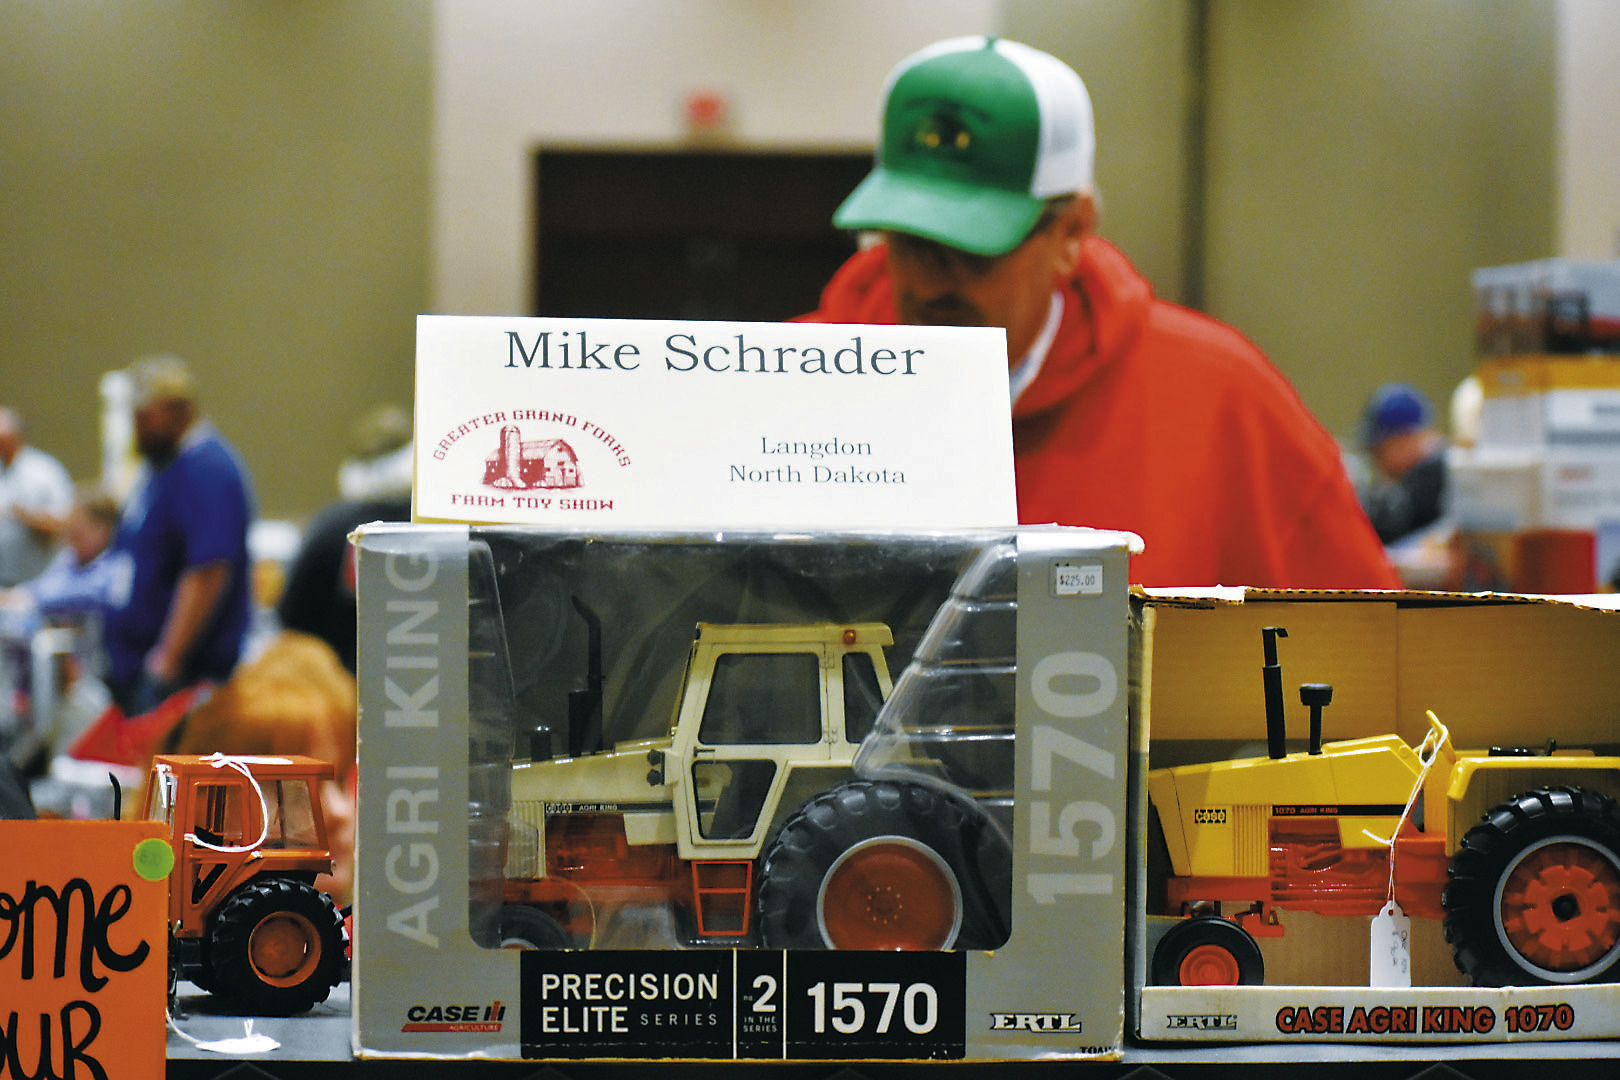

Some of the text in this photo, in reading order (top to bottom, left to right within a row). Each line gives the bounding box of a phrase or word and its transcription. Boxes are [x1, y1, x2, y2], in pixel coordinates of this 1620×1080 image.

[504, 331, 925, 376] Mike Schrader
[433, 410, 631, 467] GREATER GRAND FORKS
[761, 436, 873, 460] Langdon
[730, 464, 907, 484] North Dakota
[451, 494, 615, 511] FARM TOY SHOW
[1059, 575, 1095, 586] $225.00
[385, 551, 440, 949] AGRI KING
[1027, 652, 1118, 904] 1570
[542, 973, 718, 1000] PRECISION
[752, 974, 777, 1013] 2
[407, 1006, 480, 1021] CASE
[542, 1006, 718, 1033] ELITE SERIES
[744, 1016, 776, 1024] IN THE
[807, 981, 939, 1034] 1570
[1276, 1003, 1575, 1033] CASE AGRI KING 1070
[743, 1024, 777, 1033] SERIES
[989, 1012, 1082, 1033] ERTL
[1167, 1014, 1237, 1030] ERTL
